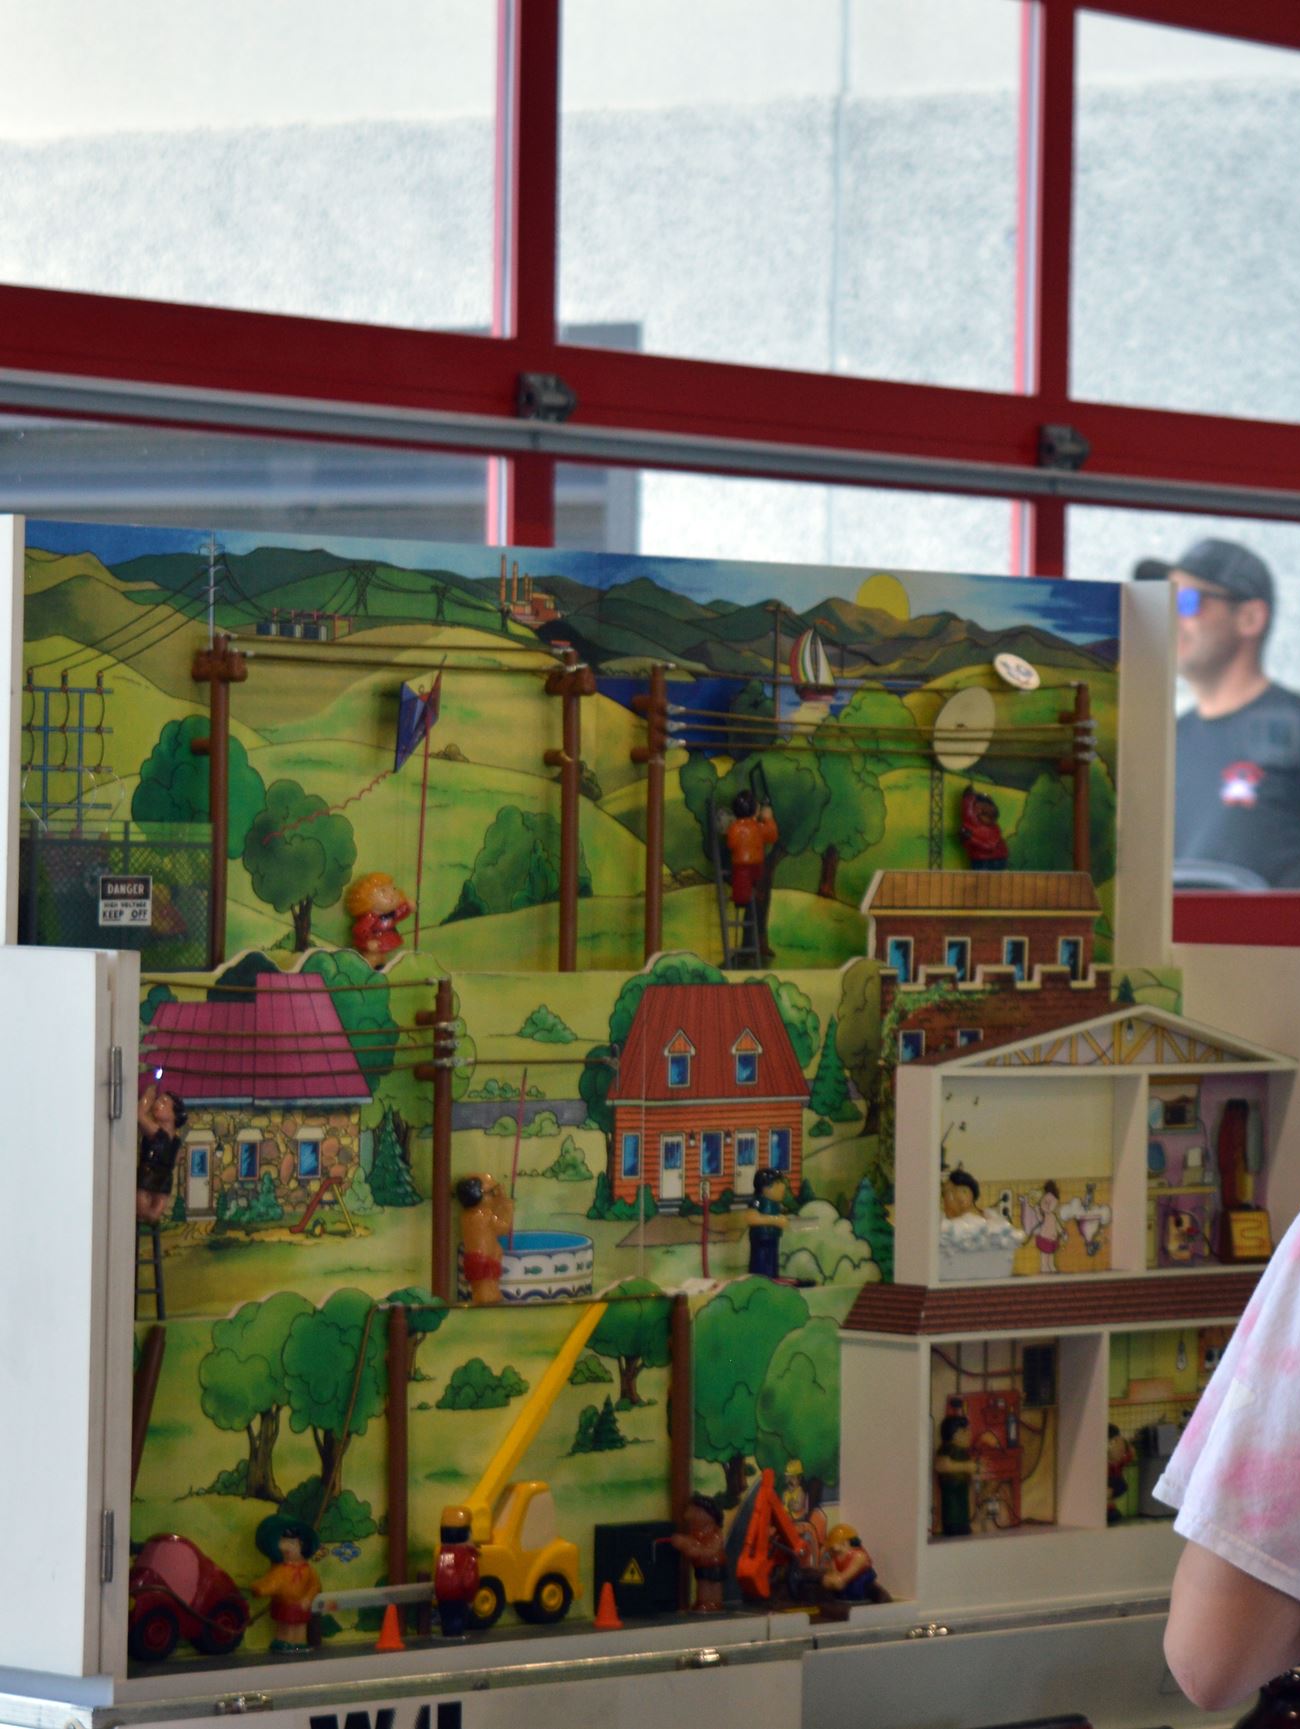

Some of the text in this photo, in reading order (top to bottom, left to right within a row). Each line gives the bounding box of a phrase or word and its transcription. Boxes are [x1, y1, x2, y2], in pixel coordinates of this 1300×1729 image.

[107, 883, 145, 895] DANGER
[103, 910, 148, 919] KEEP OFF
